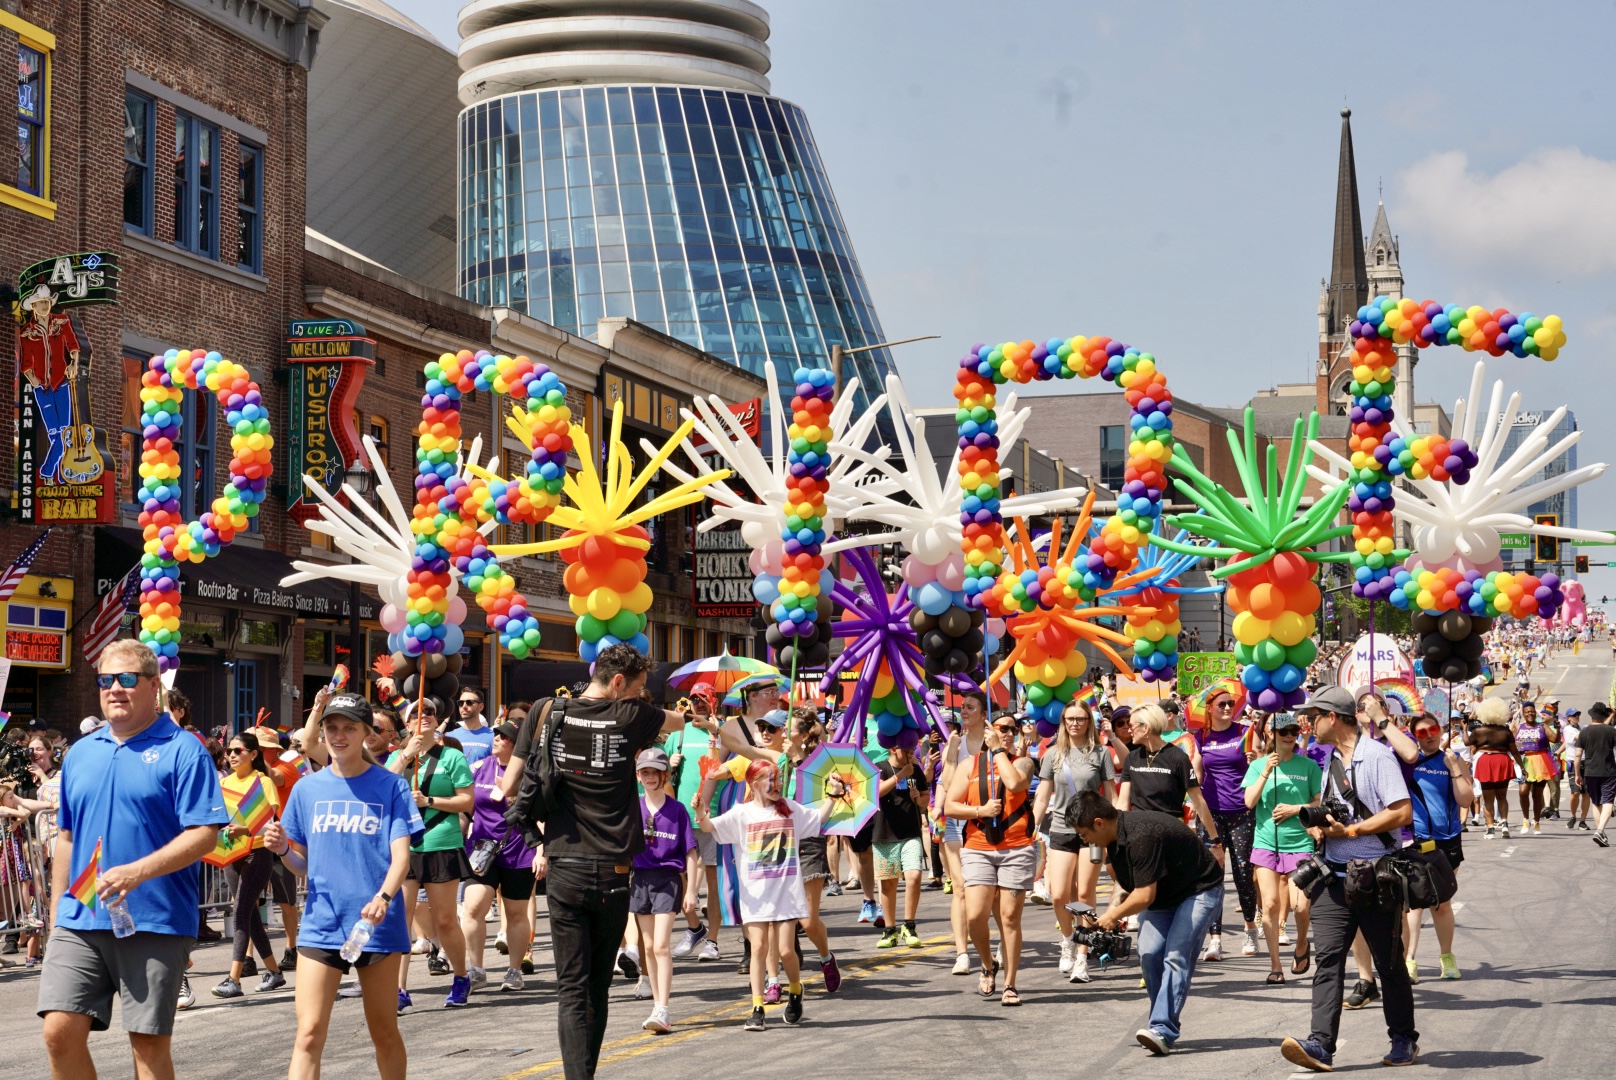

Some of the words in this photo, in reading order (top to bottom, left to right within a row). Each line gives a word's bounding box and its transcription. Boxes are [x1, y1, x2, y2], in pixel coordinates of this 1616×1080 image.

[307, 326, 333, 335] LIVE
[291, 341, 351, 357] MELLOW
[23, 383, 33, 428] ALAN
[1497, 411, 1541, 425] Badley
[22, 438, 33, 519] JACKSON
[41, 499, 97, 520] BAR
[695, 529, 752, 549] BARBEQU
[1501, 536, 1513, 545] ewis
[696, 553, 751, 578] HONKY
[198, 580, 226, 599] Rooftop
[226, 584, 239, 600] Bar
[253, 588, 271, 605] Pizza
[271, 591, 294, 608] Bakers
[295, 594, 313, 611] Since
[314, 597, 329, 613] 1974
[696, 579, 754, 603] TONK
[697, 607, 752, 616] NASHVILLE
[15, 631, 30, 642] FIVE
[31, 633, 60, 645] O'CLOCK
[1184, 655, 1229, 673] GIFT
[1357, 650, 1394, 661] MARS
[1182, 674, 1230, 690] HOR
[564, 716, 592, 728] FOUNDRY
[312, 814, 380, 835] KPMG
